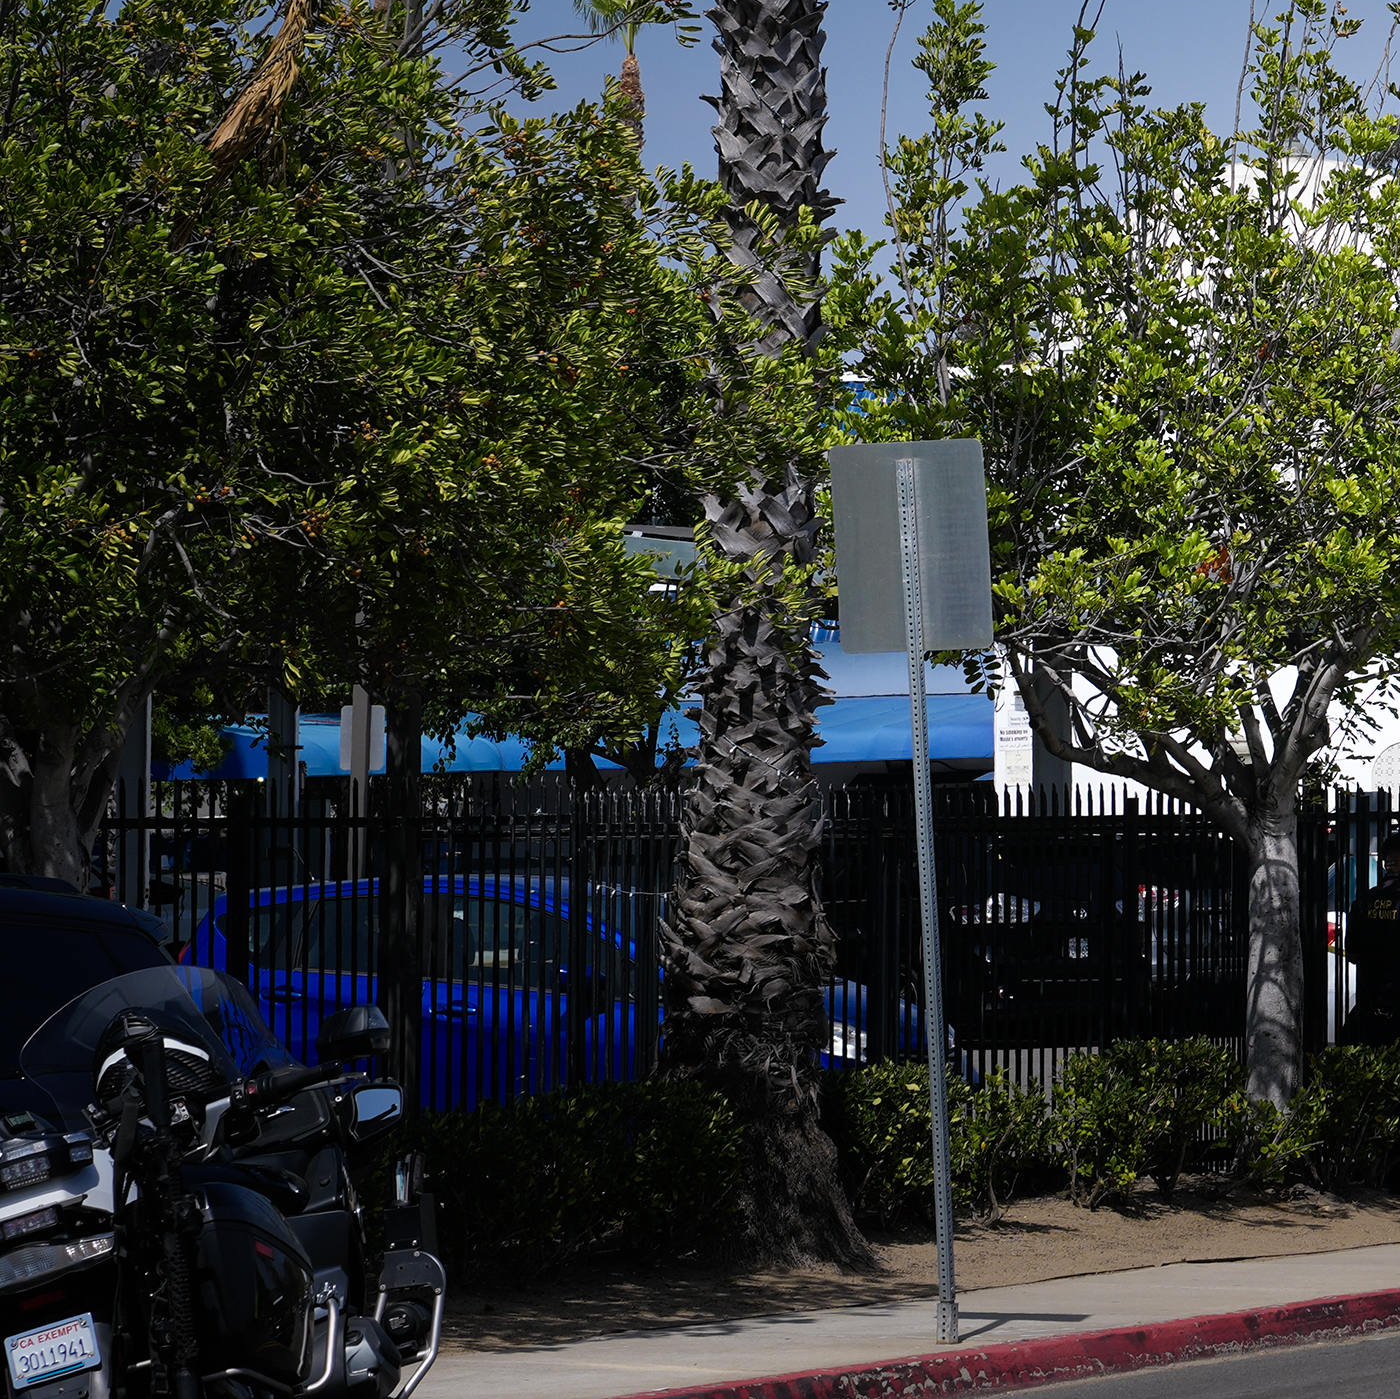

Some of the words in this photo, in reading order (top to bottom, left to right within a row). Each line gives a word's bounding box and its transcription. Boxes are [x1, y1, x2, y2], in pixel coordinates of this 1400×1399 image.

[1378, 910, 1398, 920] UNIT
[20, 1338, 34, 1349] CA
[38, 1323, 79, 1344] EXEMPT
[18, 1338, 88, 1374] 3011941
